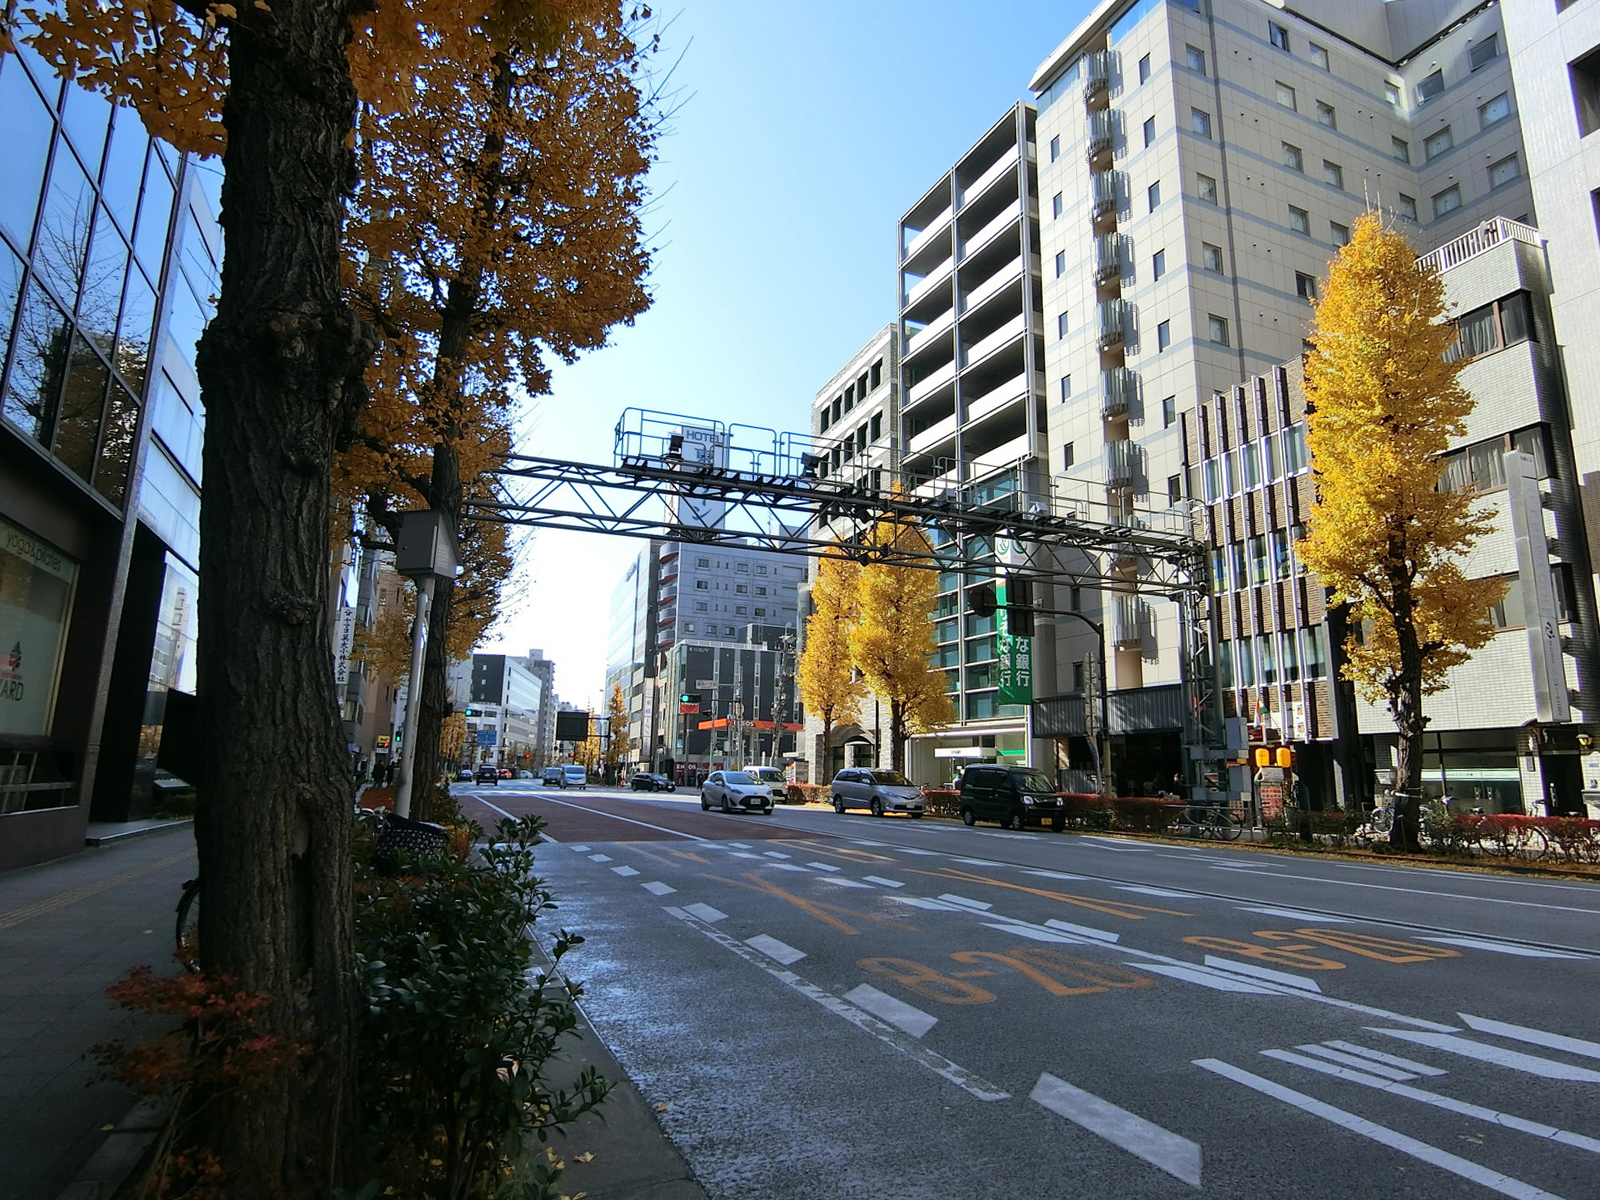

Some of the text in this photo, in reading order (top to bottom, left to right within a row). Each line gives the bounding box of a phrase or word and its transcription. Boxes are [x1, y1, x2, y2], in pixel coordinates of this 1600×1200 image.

[686, 430, 722, 443] HOTEL
[0, 678, 24, 702] ARD
[1181, 928, 1464, 970] 8-20
[857, 947, 1157, 1004] 8-20
